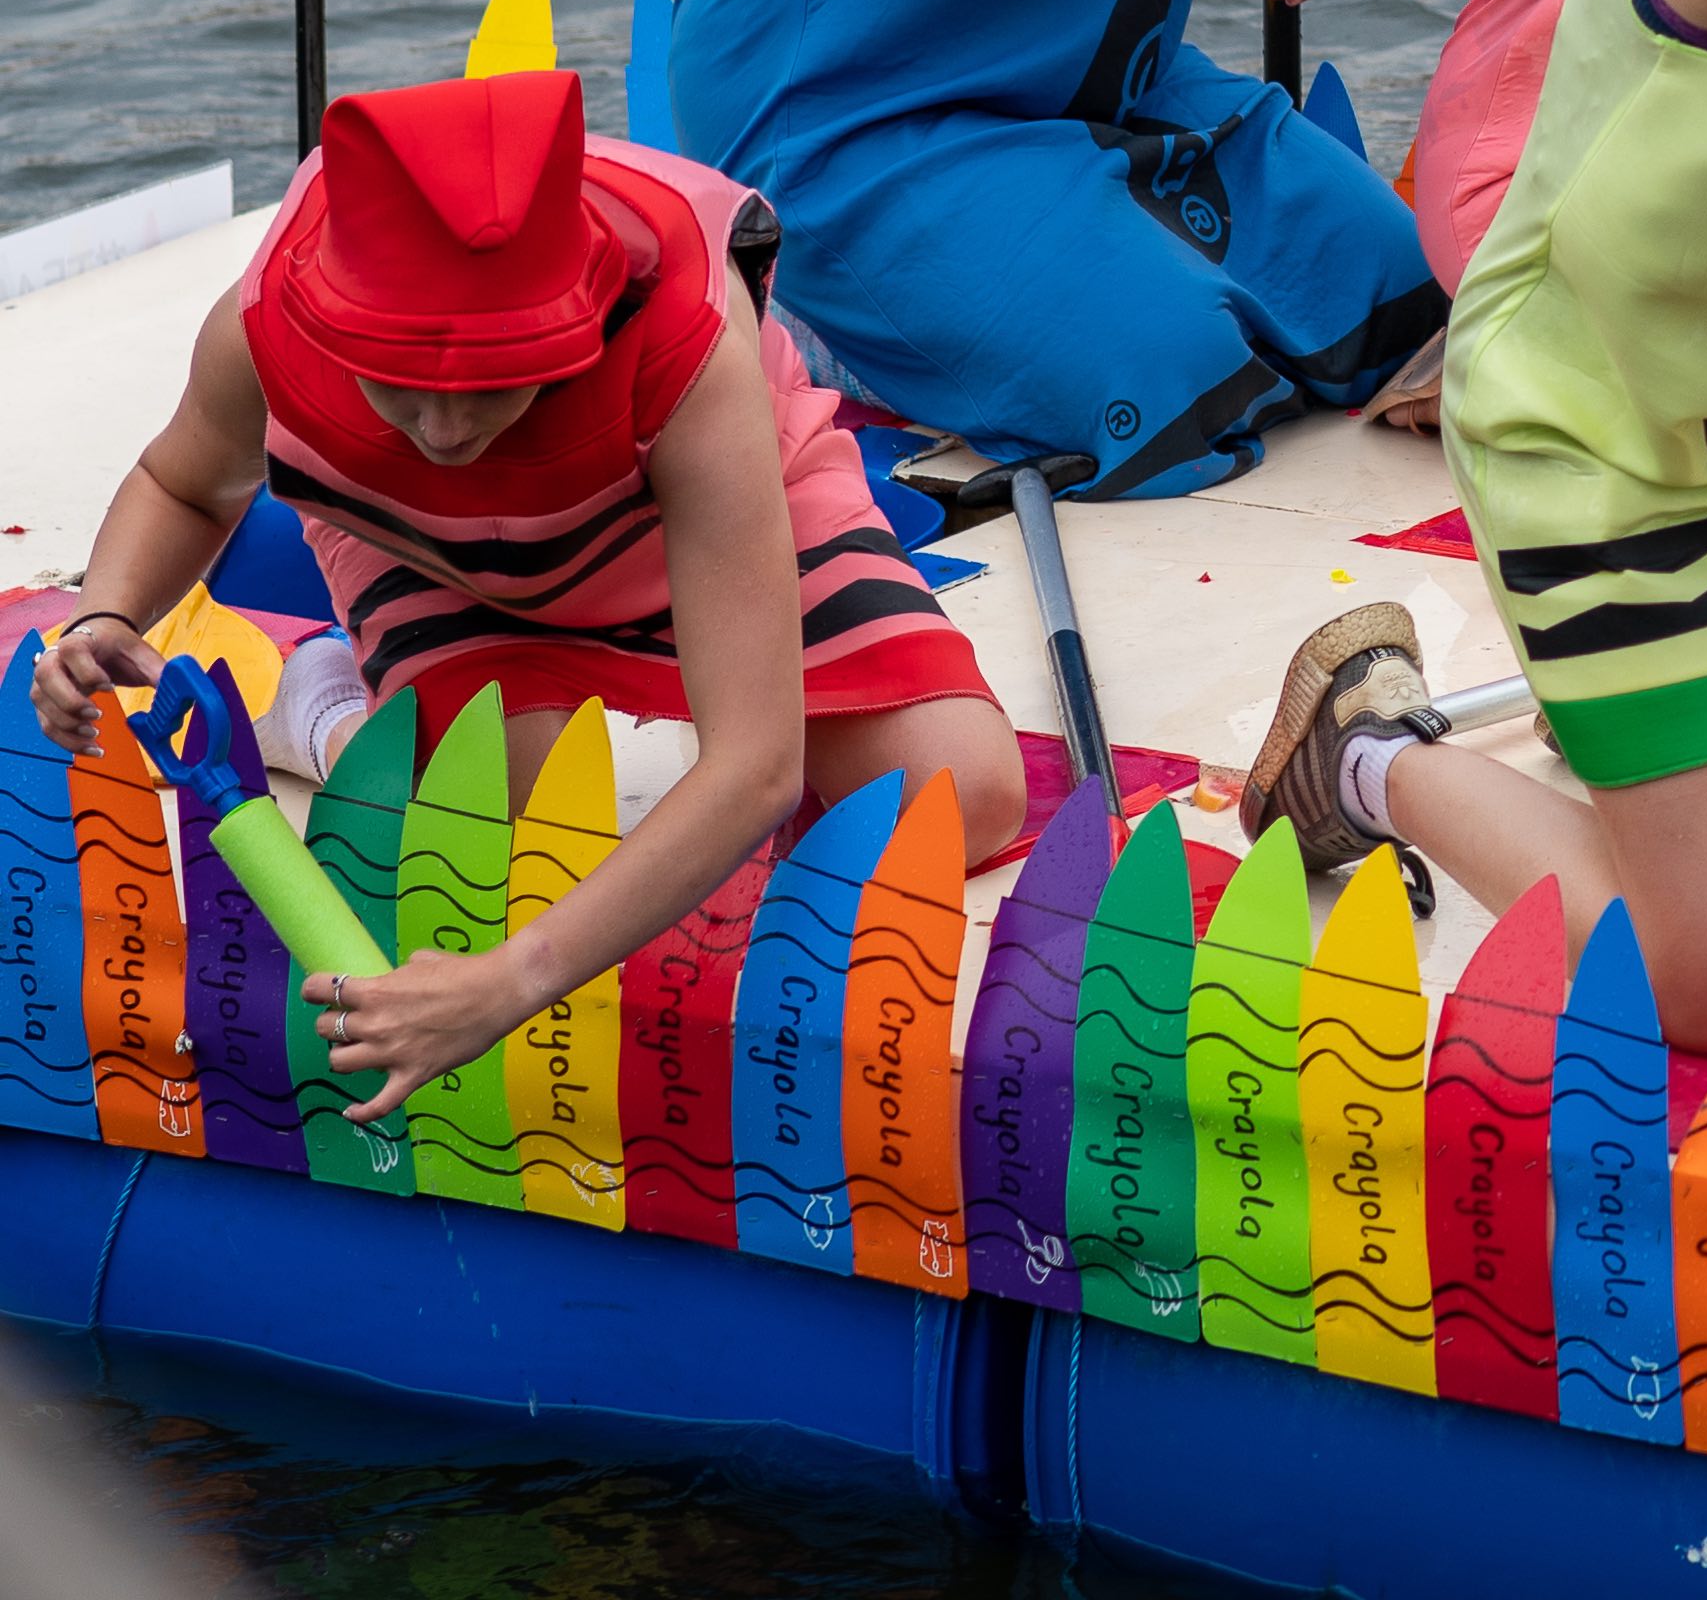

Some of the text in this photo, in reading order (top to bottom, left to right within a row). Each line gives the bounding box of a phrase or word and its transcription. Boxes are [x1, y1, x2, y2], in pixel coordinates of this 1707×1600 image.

[0, 866, 57, 1041] Crayola
[103, 883, 150, 1049] Crayola
[197, 889, 261, 1067] Crayola
[526, 999, 589, 1124] ayola
[636, 955, 703, 1126] Crayola
[748, 975, 818, 1146] Crayola
[862, 997, 915, 1167] Crayola
[972, 1026, 1041, 1197] Crayola
[1085, 1062, 1161, 1247] Crayola
[1214, 1070, 1274, 1239] Crayola
[1333, 1102, 1396, 1265] Crayola
[1454, 1123, 1505, 1282] Crayola
[1576, 1141, 1646, 1319] Crayola
